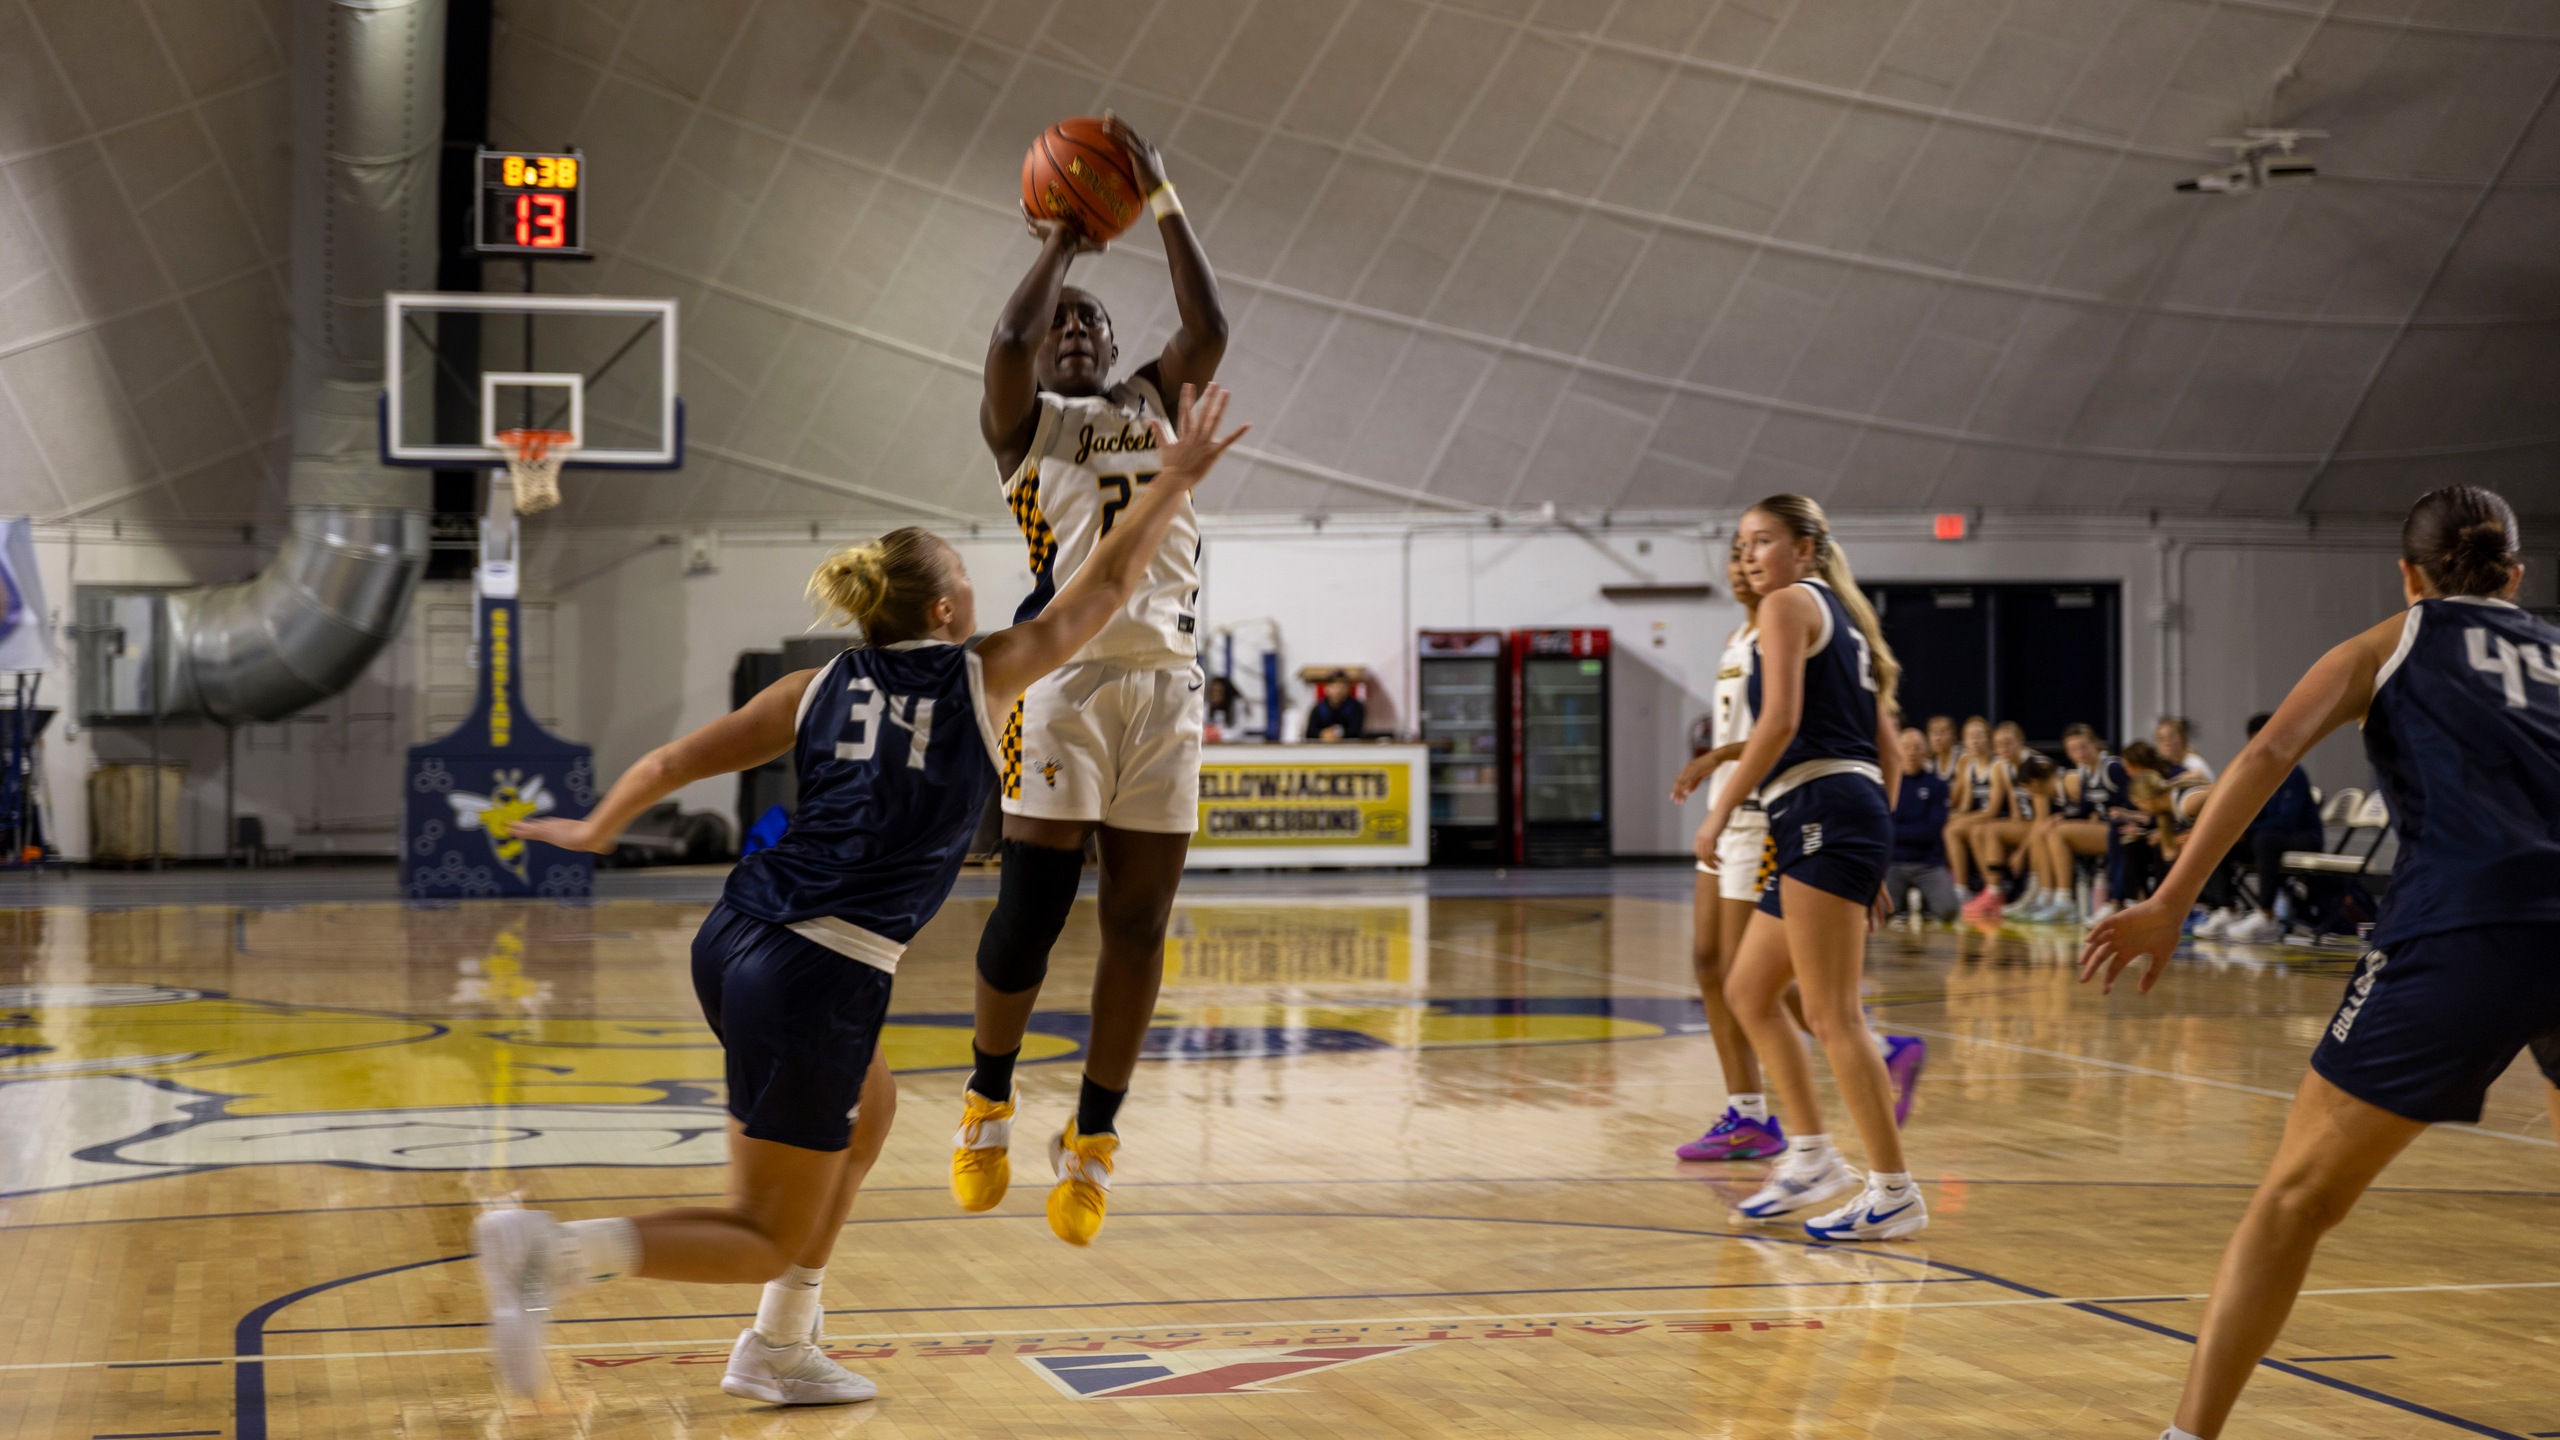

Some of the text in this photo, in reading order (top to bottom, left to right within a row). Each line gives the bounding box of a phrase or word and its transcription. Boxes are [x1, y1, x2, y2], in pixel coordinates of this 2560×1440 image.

[515, 194, 566, 248] 13
[835, 677, 937, 771] 34
[1199, 772, 1387, 798] ELLOWJACKETS
[576, 1320, 1824, 1367] HEART OF AMERCA
[1310, 1319, 1646, 1334] ATHLETIC
